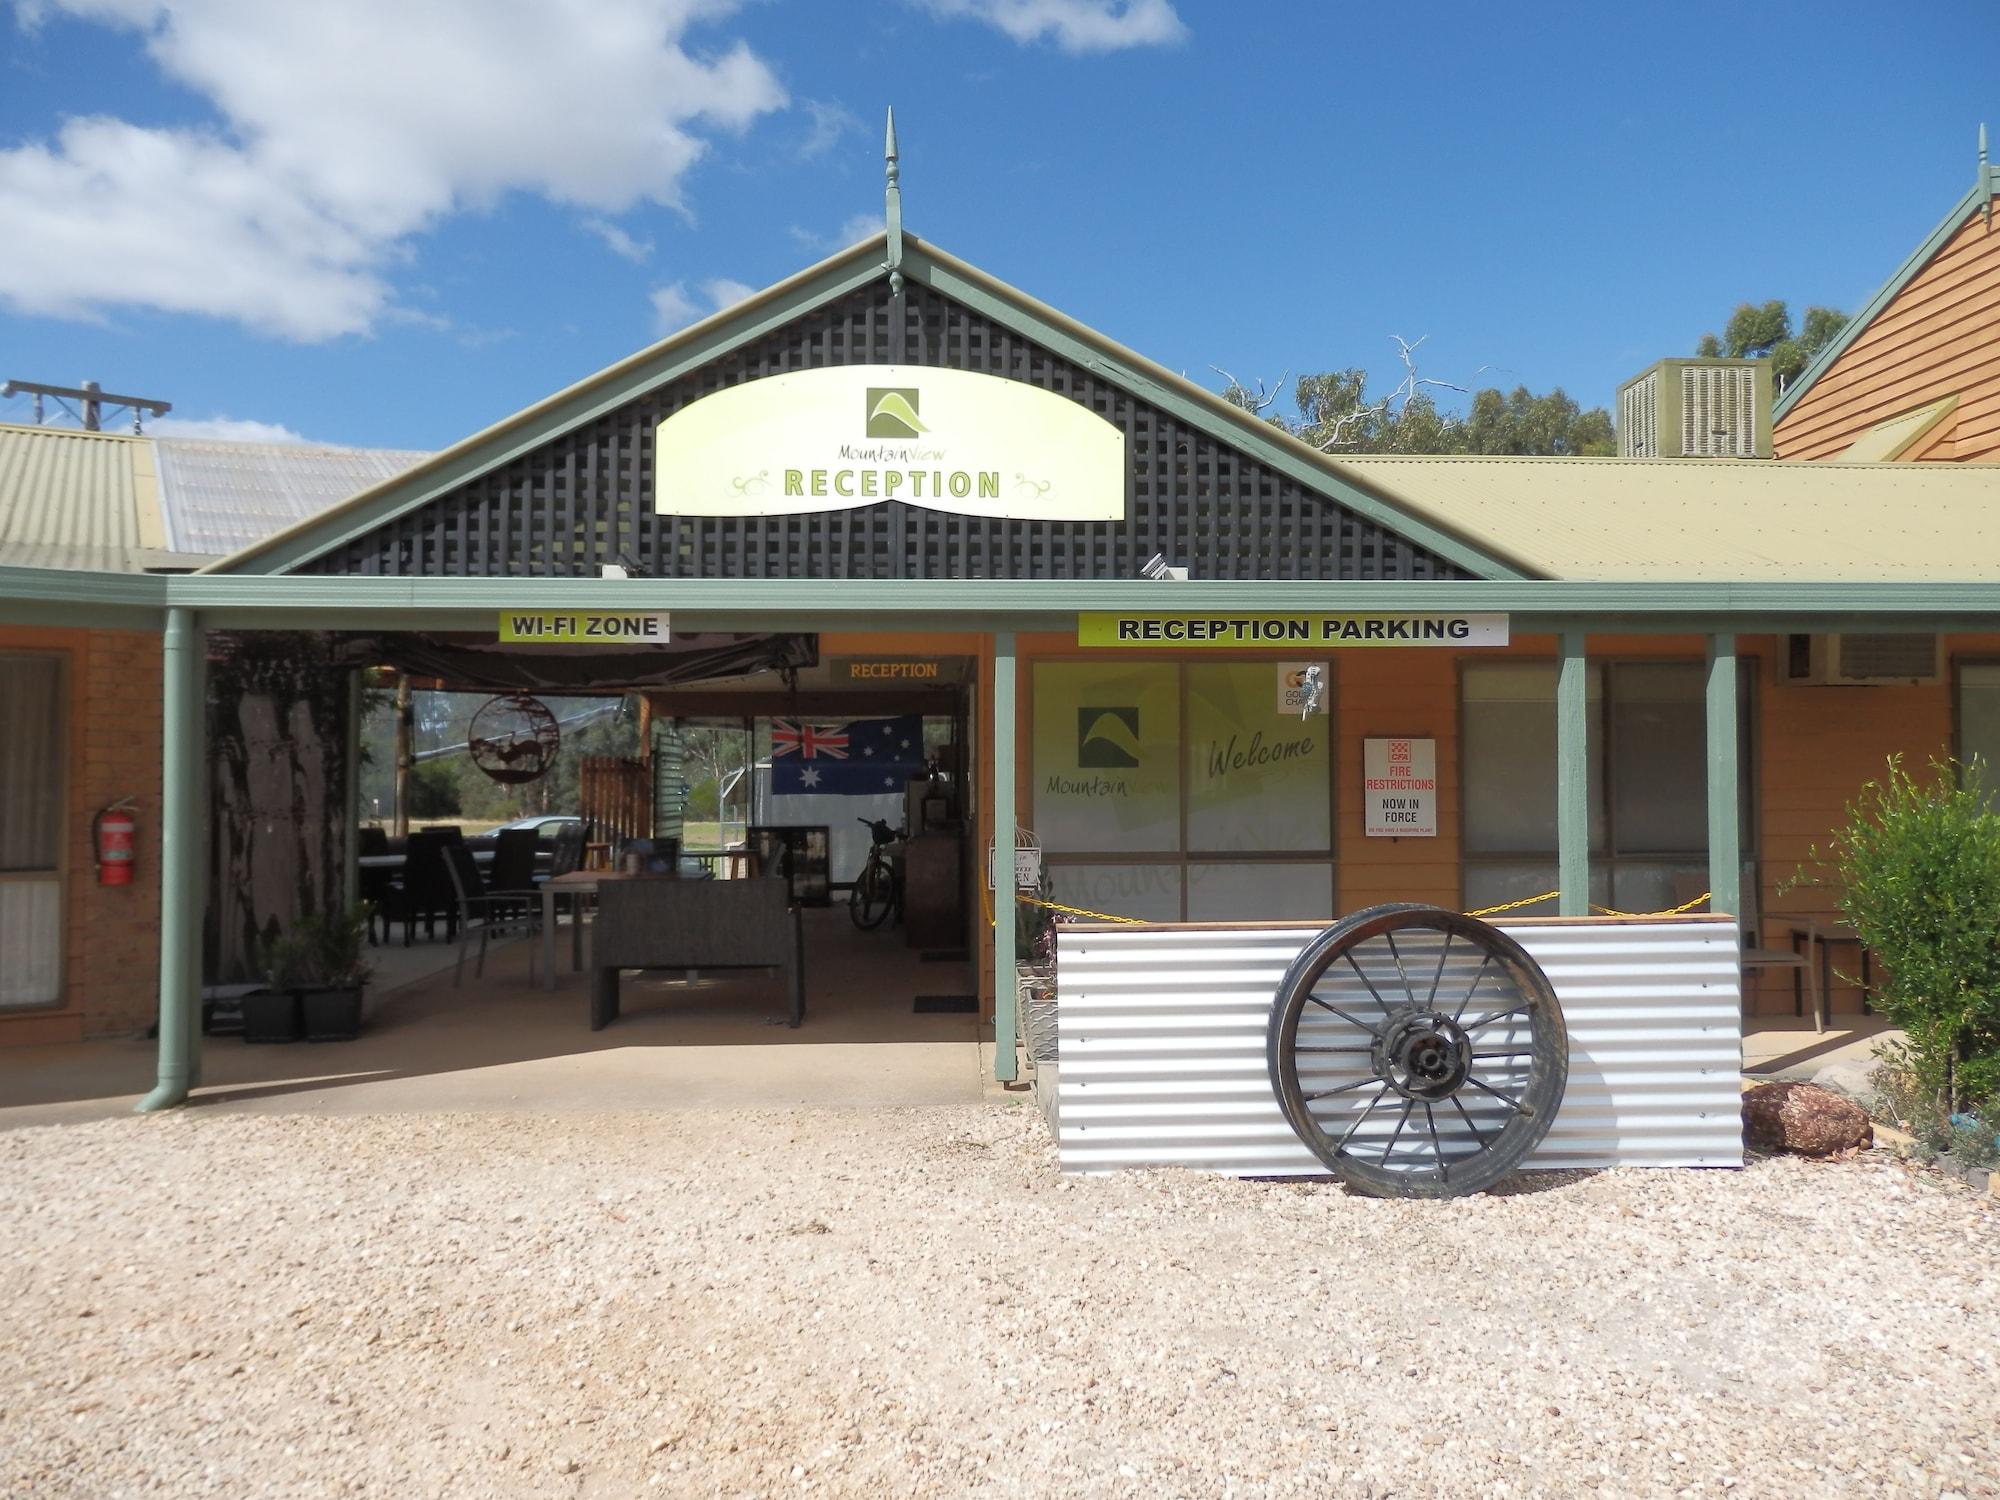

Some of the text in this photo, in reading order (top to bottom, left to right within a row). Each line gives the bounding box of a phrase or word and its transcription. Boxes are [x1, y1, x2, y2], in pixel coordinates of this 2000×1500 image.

[785, 470, 999, 498] RECEPTION
[512, 616, 658, 636] WI-FI ZONE
[1119, 619, 1469, 640] RECEPTION PARKING
[850, 663, 938, 678] RECEPTION
[1208, 730, 1314, 779] Welcome
[1391, 753, 1409, 761] CFA
[1389, 766, 1412, 777] FIRE
[1366, 779, 1435, 791] RESTRICTIONS
[1382, 799, 1420, 809] NOW IN
[1385, 812, 1417, 823] FORCE
